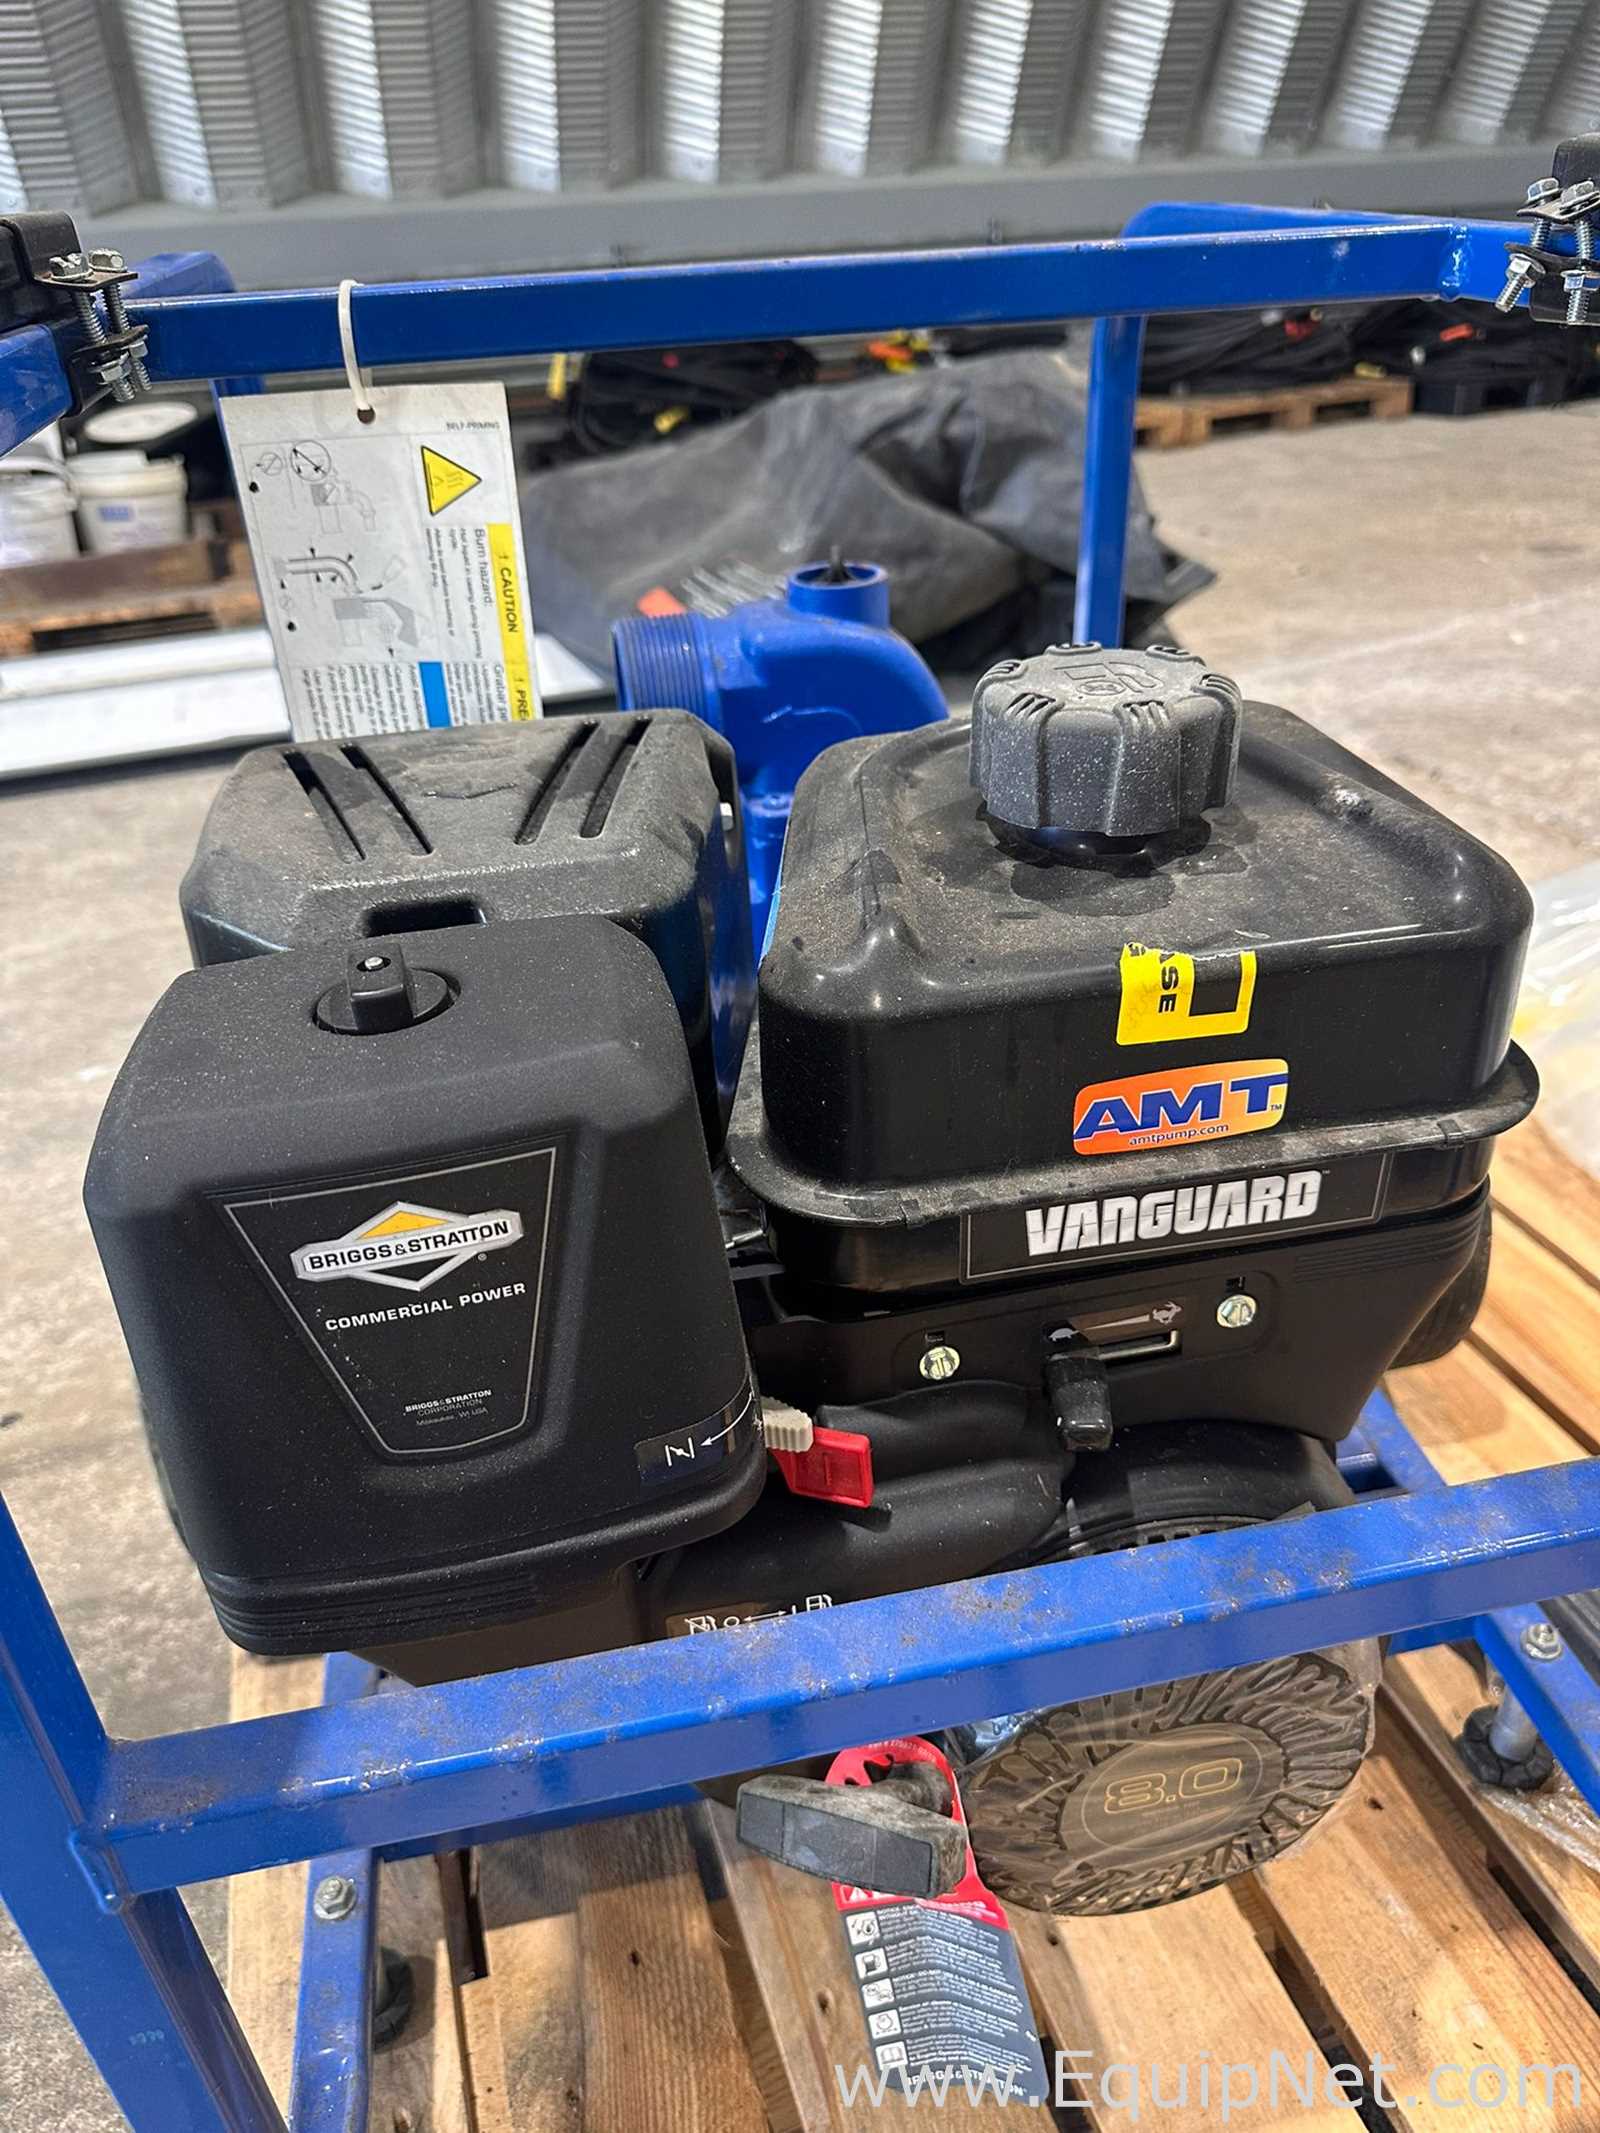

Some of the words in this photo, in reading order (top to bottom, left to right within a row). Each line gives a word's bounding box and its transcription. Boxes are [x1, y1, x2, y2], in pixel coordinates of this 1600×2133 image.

[501, 567, 518, 633] CAUTION
[1074, 1073, 1288, 1139] AMT
[1129, 1124, 1229, 1146] amtpump.com
[1025, 1170, 1322, 1256] VANGUARD
[309, 1220, 509, 1270] BRIGGS&STRATTON
[325, 1298, 453, 1331] COMMERCIAL
[459, 1283, 526, 1307] POWER
[1104, 1757, 1243, 1815] 8.0
